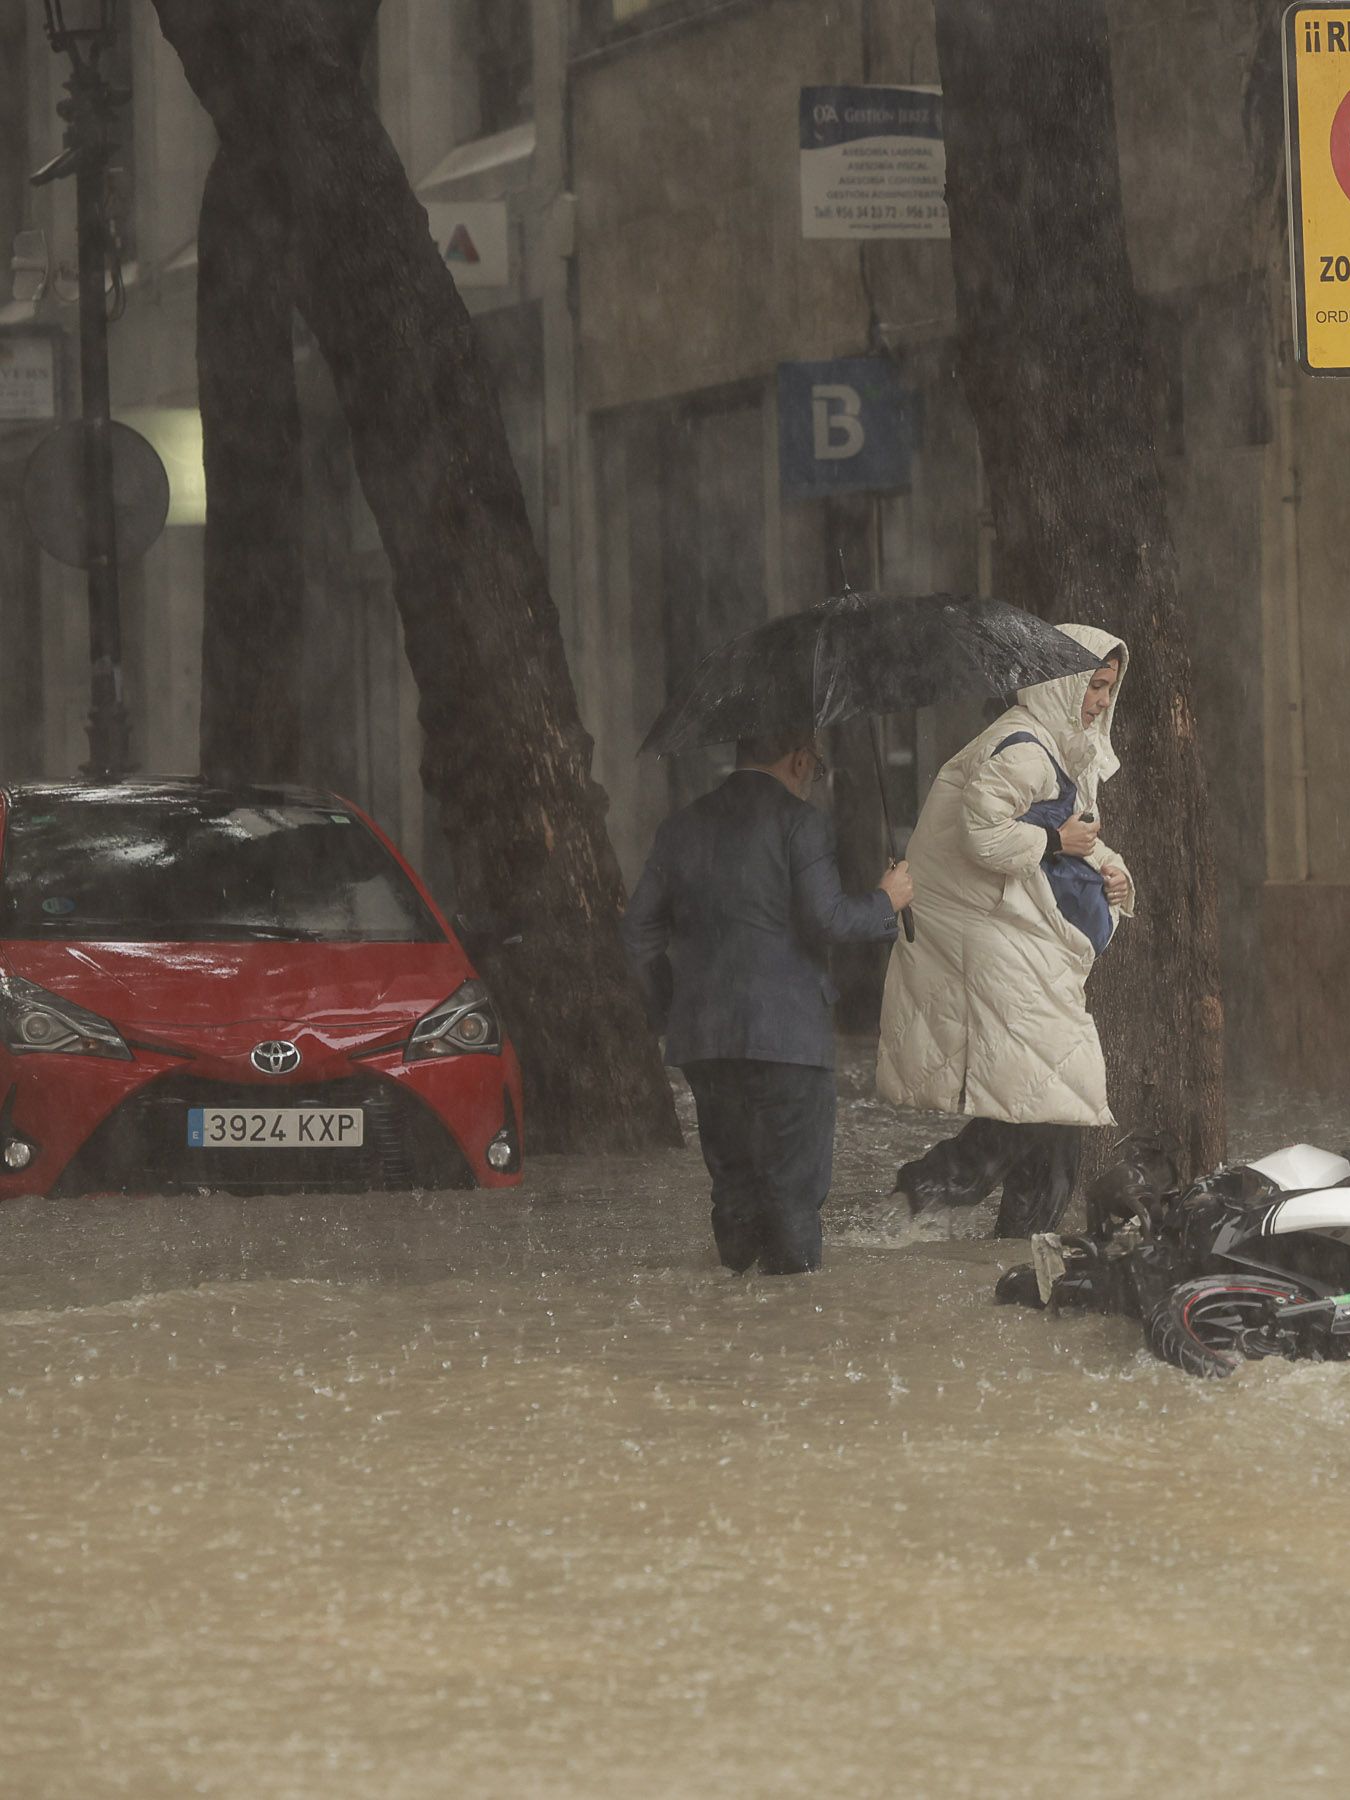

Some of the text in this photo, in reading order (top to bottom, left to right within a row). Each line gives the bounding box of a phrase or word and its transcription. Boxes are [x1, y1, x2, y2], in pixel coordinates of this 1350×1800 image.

[812, 384, 865, 460] B
[192, 1114, 355, 1142] E 3924 KXP
